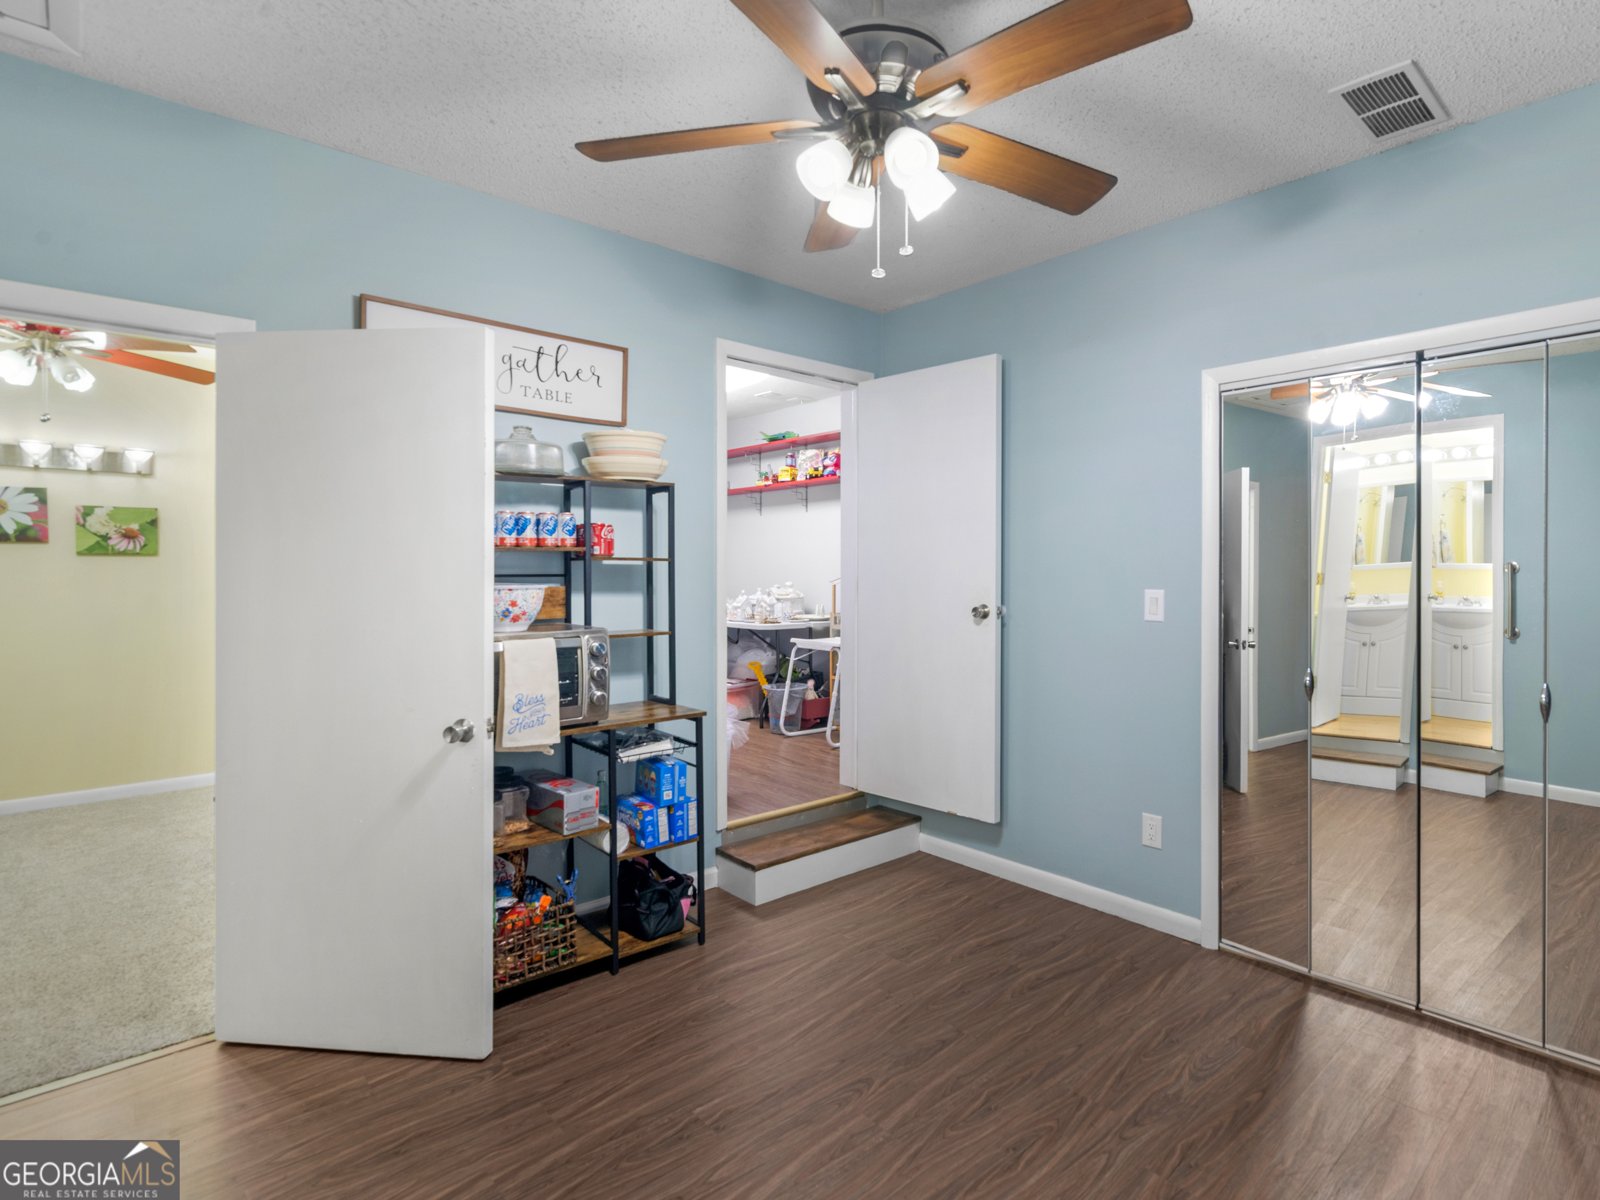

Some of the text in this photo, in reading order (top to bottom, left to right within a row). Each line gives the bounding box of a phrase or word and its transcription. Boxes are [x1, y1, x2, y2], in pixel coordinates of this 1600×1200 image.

[496, 344, 602, 394] gather
[520, 384, 573, 404] TABLE
[512, 693, 545, 713] Bless
